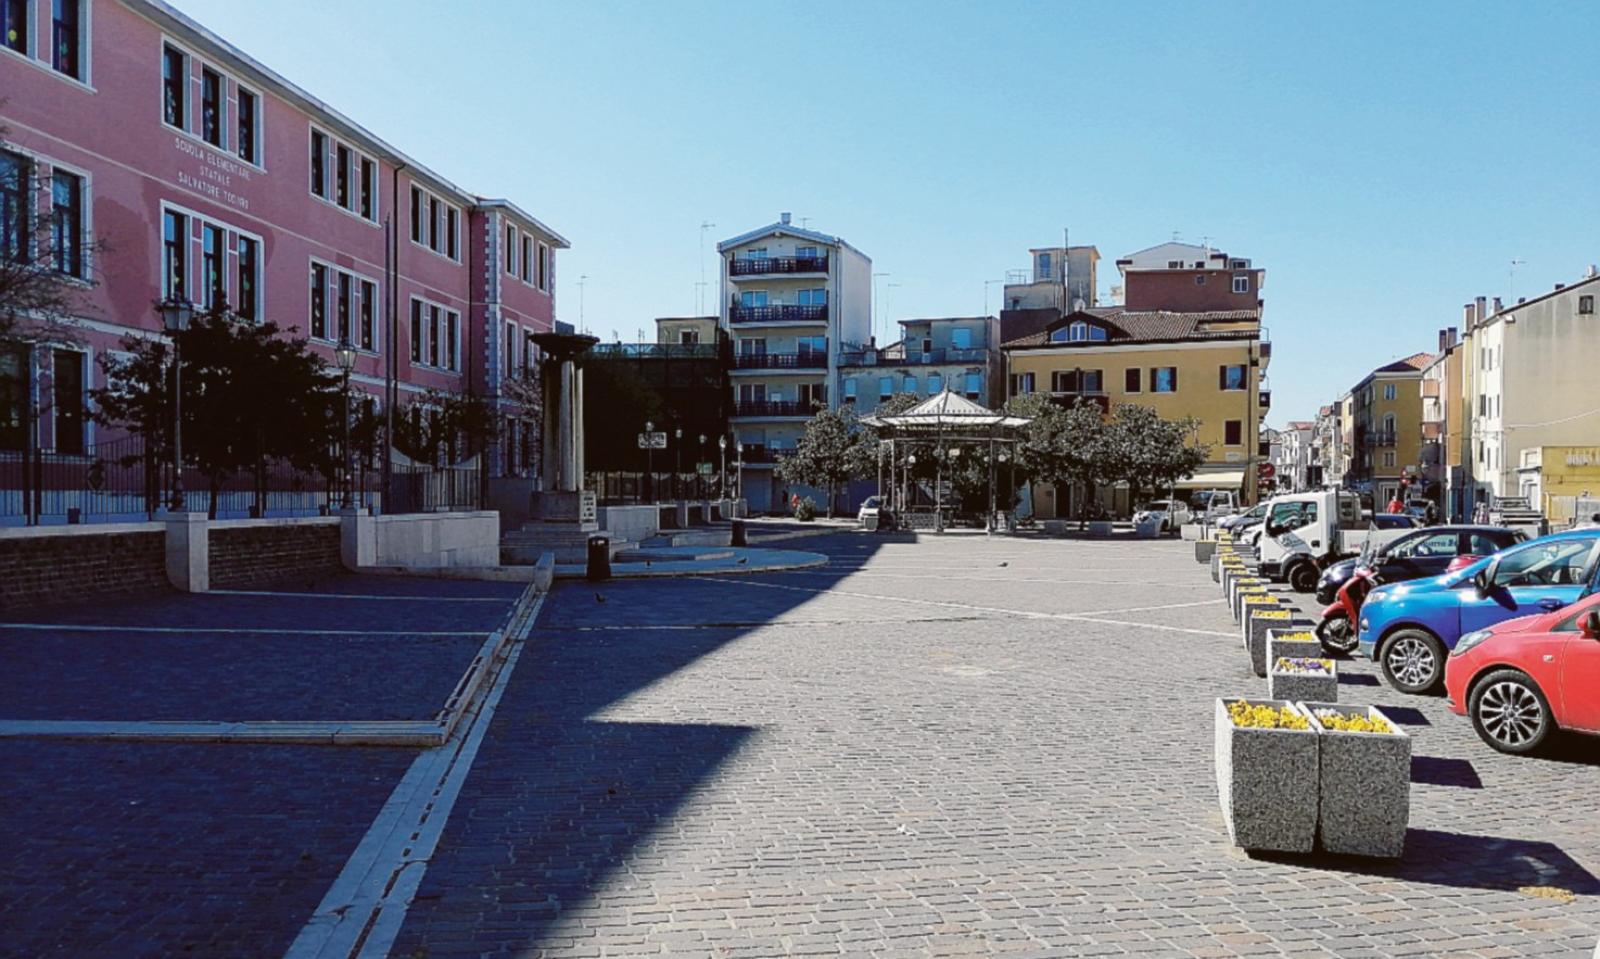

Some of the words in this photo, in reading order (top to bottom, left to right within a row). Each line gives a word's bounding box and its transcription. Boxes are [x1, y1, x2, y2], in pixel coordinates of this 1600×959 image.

[175, 137, 204, 161] SCUOLA
[178, 171, 220, 198] SALVATORE
[200, 165, 231, 187] STATALE
